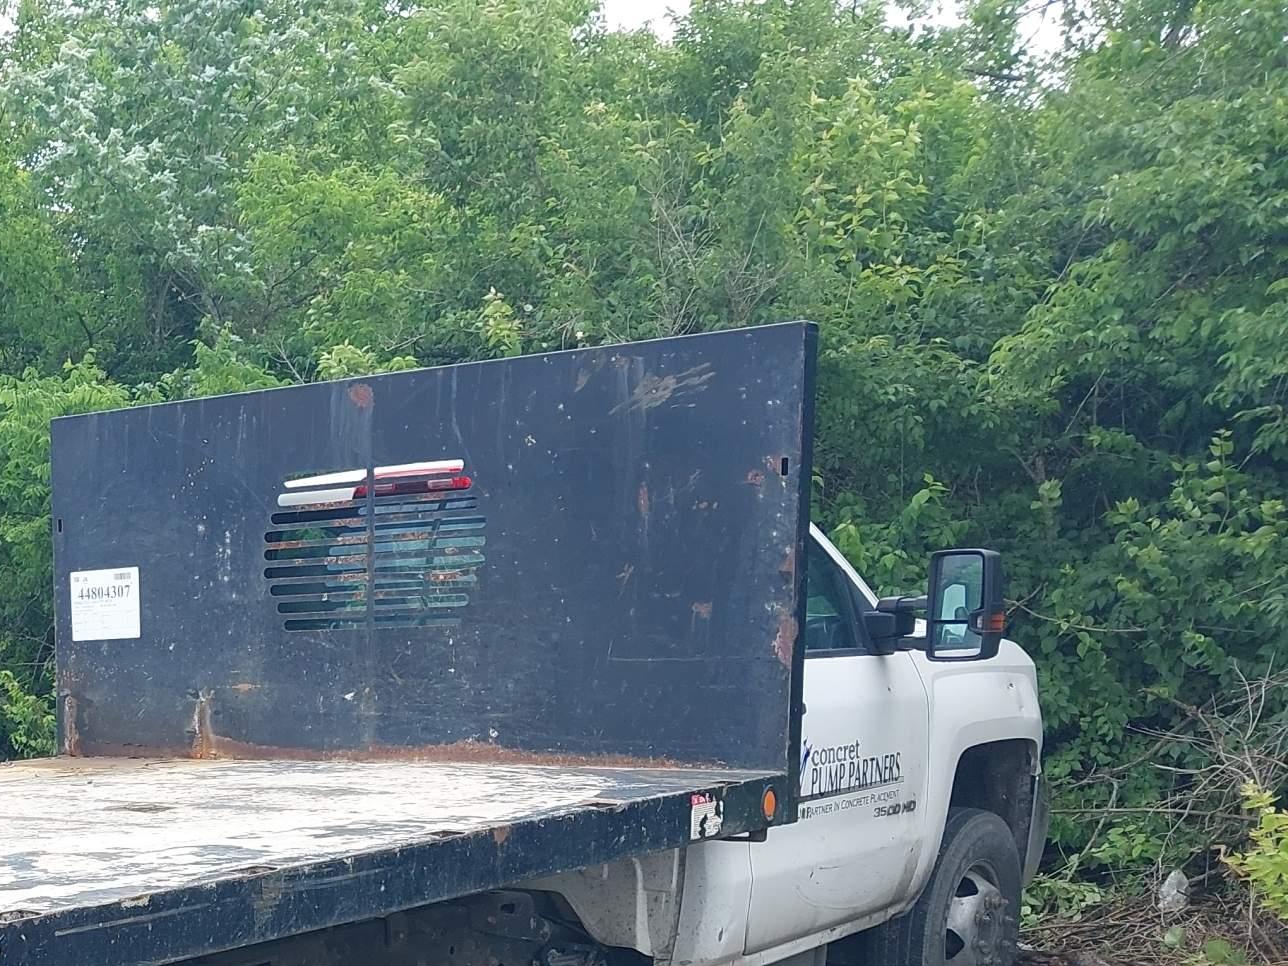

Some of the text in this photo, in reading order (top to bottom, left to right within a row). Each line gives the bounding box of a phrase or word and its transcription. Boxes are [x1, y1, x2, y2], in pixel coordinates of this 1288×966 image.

[78, 585, 130, 600] 44804307
[811, 740, 860, 766] concret
[811, 752, 901, 797] PUMP PARTNERS
[841, 796, 870, 810] CONCRETE
[873, 800, 916, 817] 3500 HD
